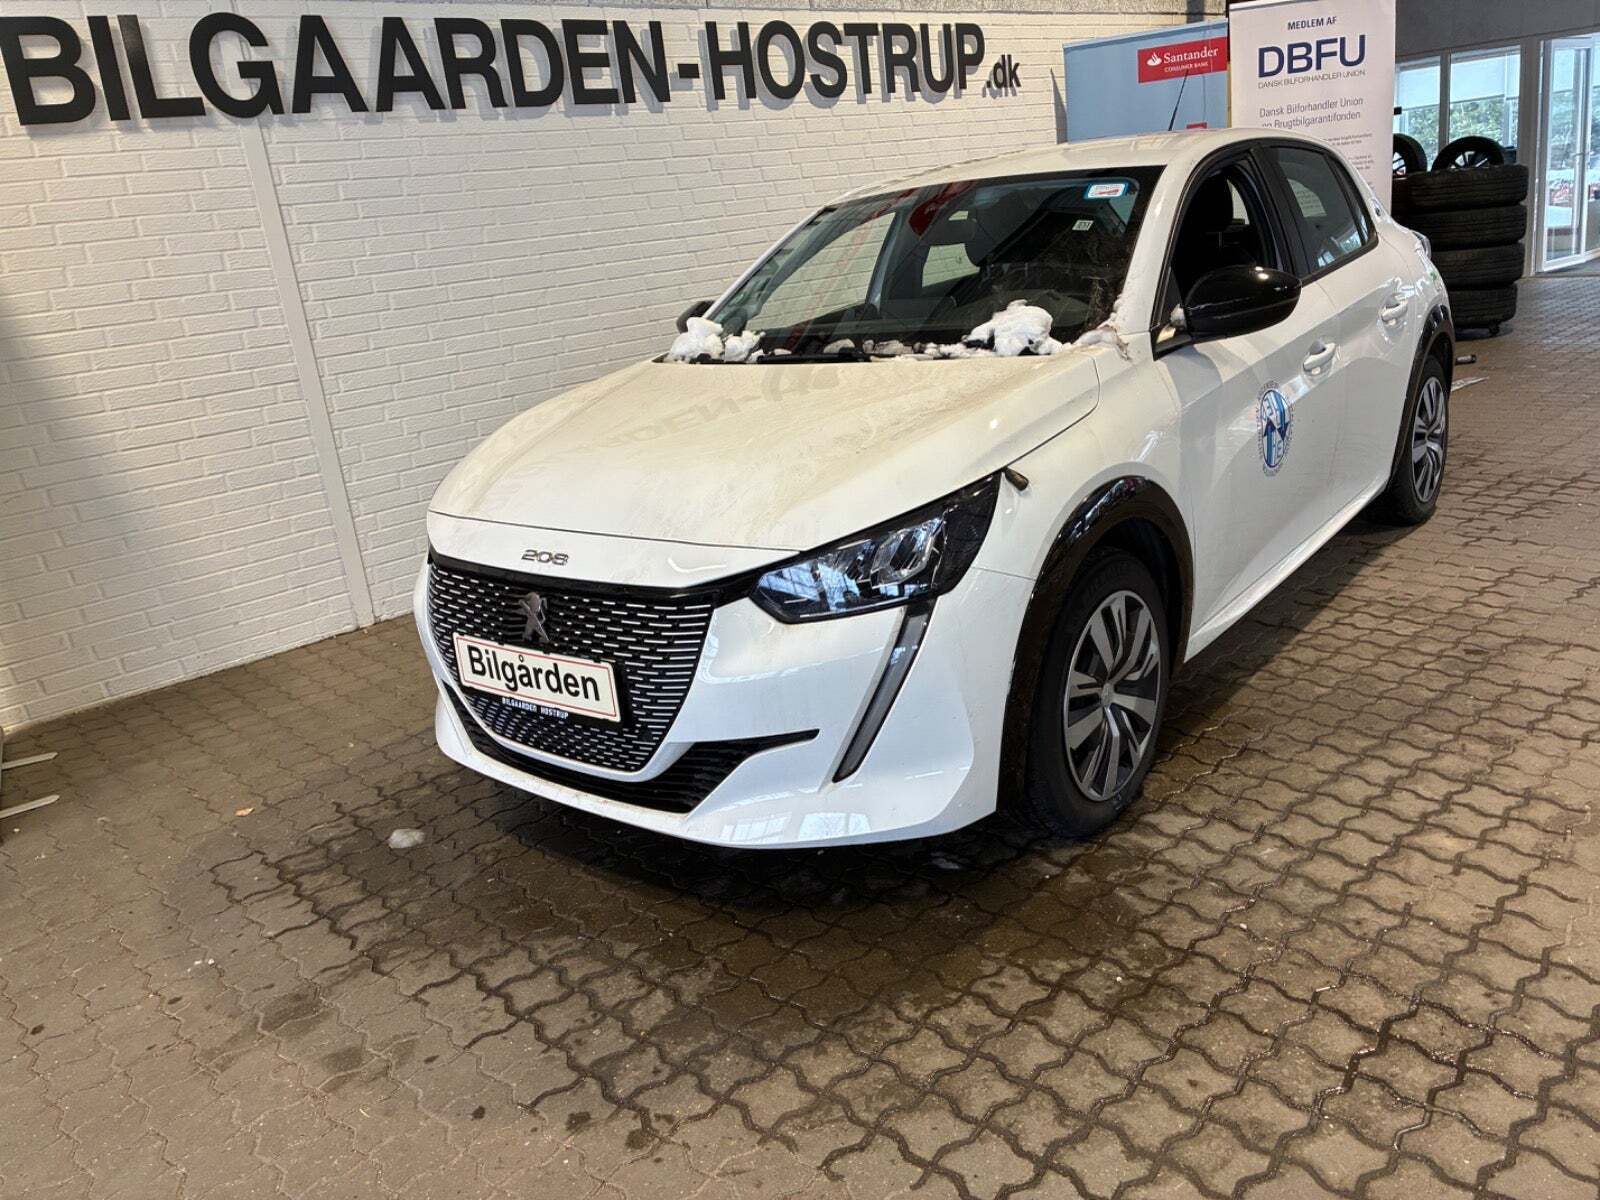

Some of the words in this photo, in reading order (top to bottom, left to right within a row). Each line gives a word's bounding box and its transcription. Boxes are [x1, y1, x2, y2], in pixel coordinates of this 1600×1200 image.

[1287, 18, 1324, 31] MEDLEM
[1326, 16, 1337, 26] AF
[1163, 45, 1219, 64] Santander
[1258, 34, 1366, 78] DBFU
[1258, 79, 1284, 90] DANSK
[1284, 71, 1342, 86] BILFORHANDLER
[1342, 69, 1366, 78] UNION
[1260, 106, 1285, 118] Dansk
[1287, 99, 1338, 115] Bilforhandler
[1340, 96, 1364, 108] Union
[1274, 110, 1361, 130] Brugtbilgarantifonden
[521, 549, 569, 566] 208
[467, 645, 601, 702] Bilgården
